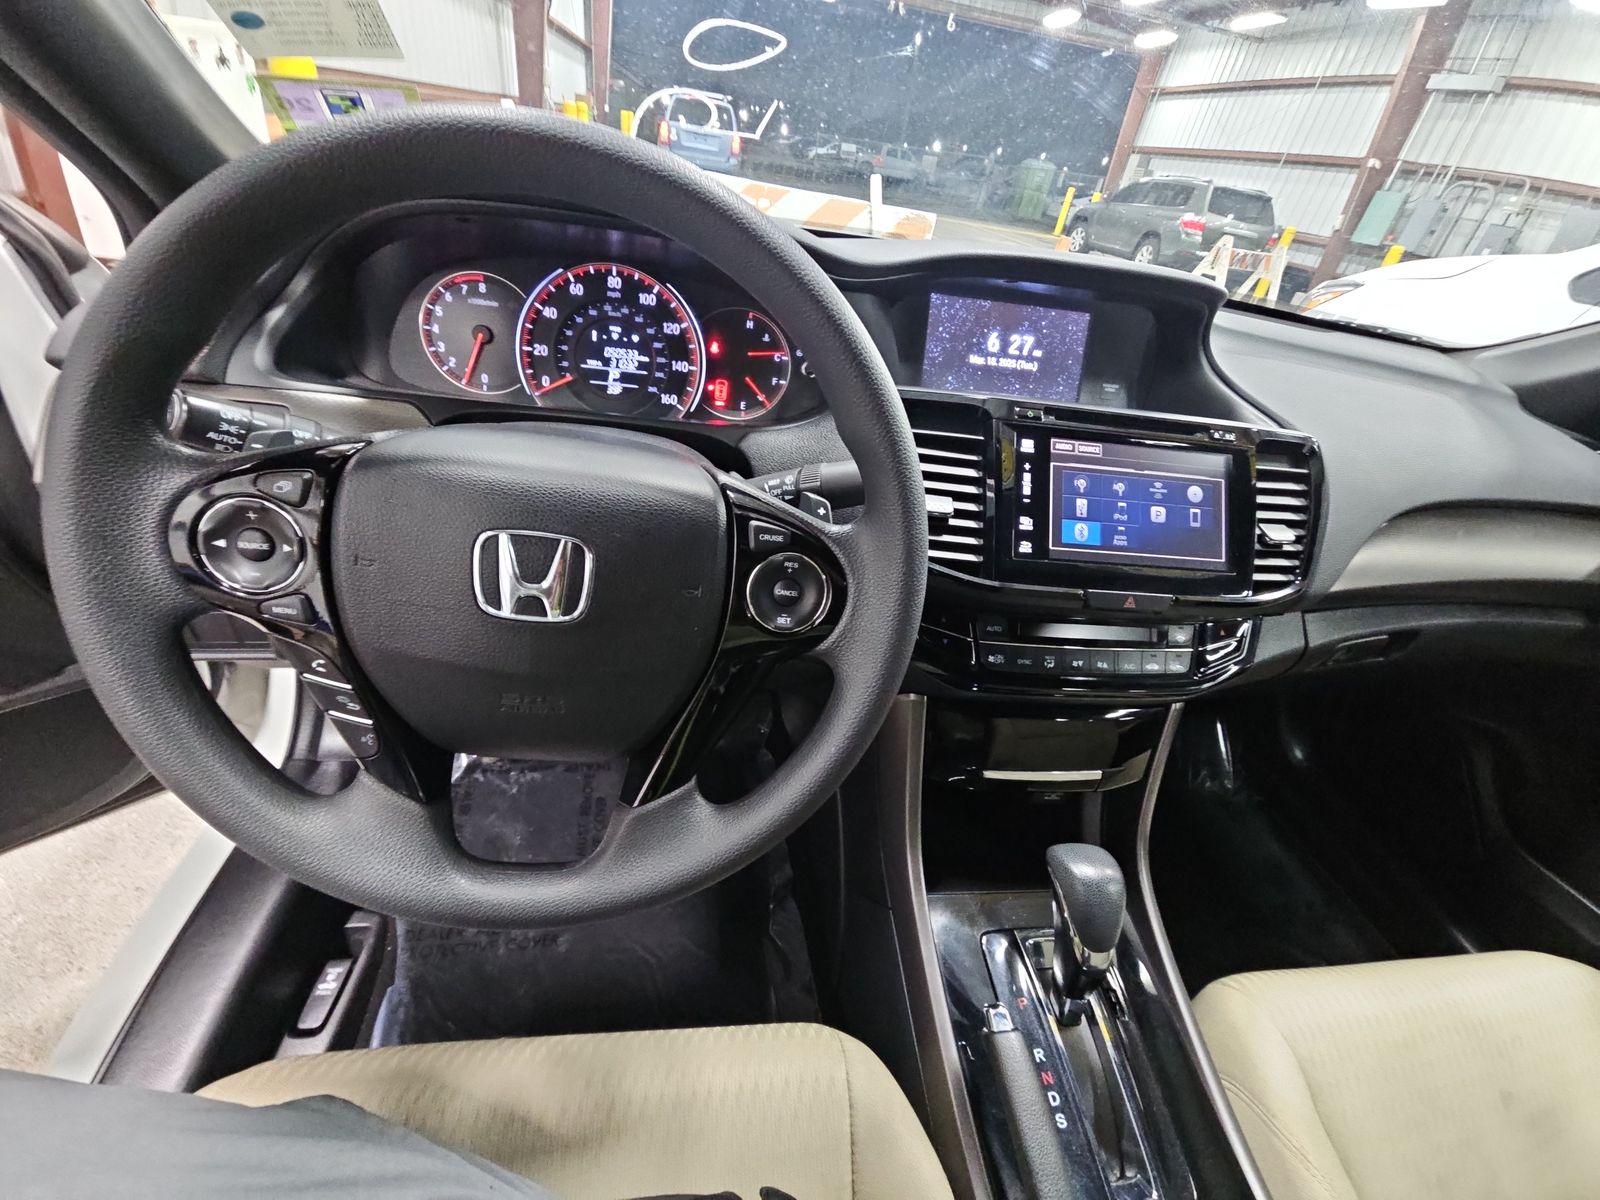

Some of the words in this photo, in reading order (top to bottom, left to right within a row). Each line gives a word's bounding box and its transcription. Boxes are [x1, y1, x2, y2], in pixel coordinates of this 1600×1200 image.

[478, 282, 486, 293] 8
[607, 276, 622, 289] 80
[460, 284, 468, 295] 7
[569, 283, 584, 296] 60
[444, 292, 453, 302] 6
[638, 293, 657, 306] 100
[435, 305, 443, 317] 5
[542, 307, 558, 319] 40
[431, 323, 439, 333] 4
[663, 322, 680, 336] 120
[746, 320, 754, 329] H
[437, 341, 445, 352] 3
[533, 344, 548, 356] 20
[448, 356, 456, 367] 2
[671, 361, 689, 372] 140
[481, 373, 489, 383] 0
[541, 375, 550, 386] 0
[660, 394, 678, 405] 160
[740, 402, 747, 410] E
[205, 432, 238, 444] AUTO
[1055, 443, 1073, 451] AUDIO
[1078, 445, 1100, 453] SOURCE
[1113, 513, 1128, 521] iPod
[759, 533, 784, 542] CRUISE
[784, 561, 799, 569] RES
[775, 589, 800, 597] CANCEL
[776, 617, 791, 625] SET
[1018, 997, 1028, 1010] P
[1033, 1048, 1046, 1063] R
[1041, 1071, 1054, 1085] N
[1048, 1091, 1060, 1107] D
[1055, 1113, 1068, 1129] S
